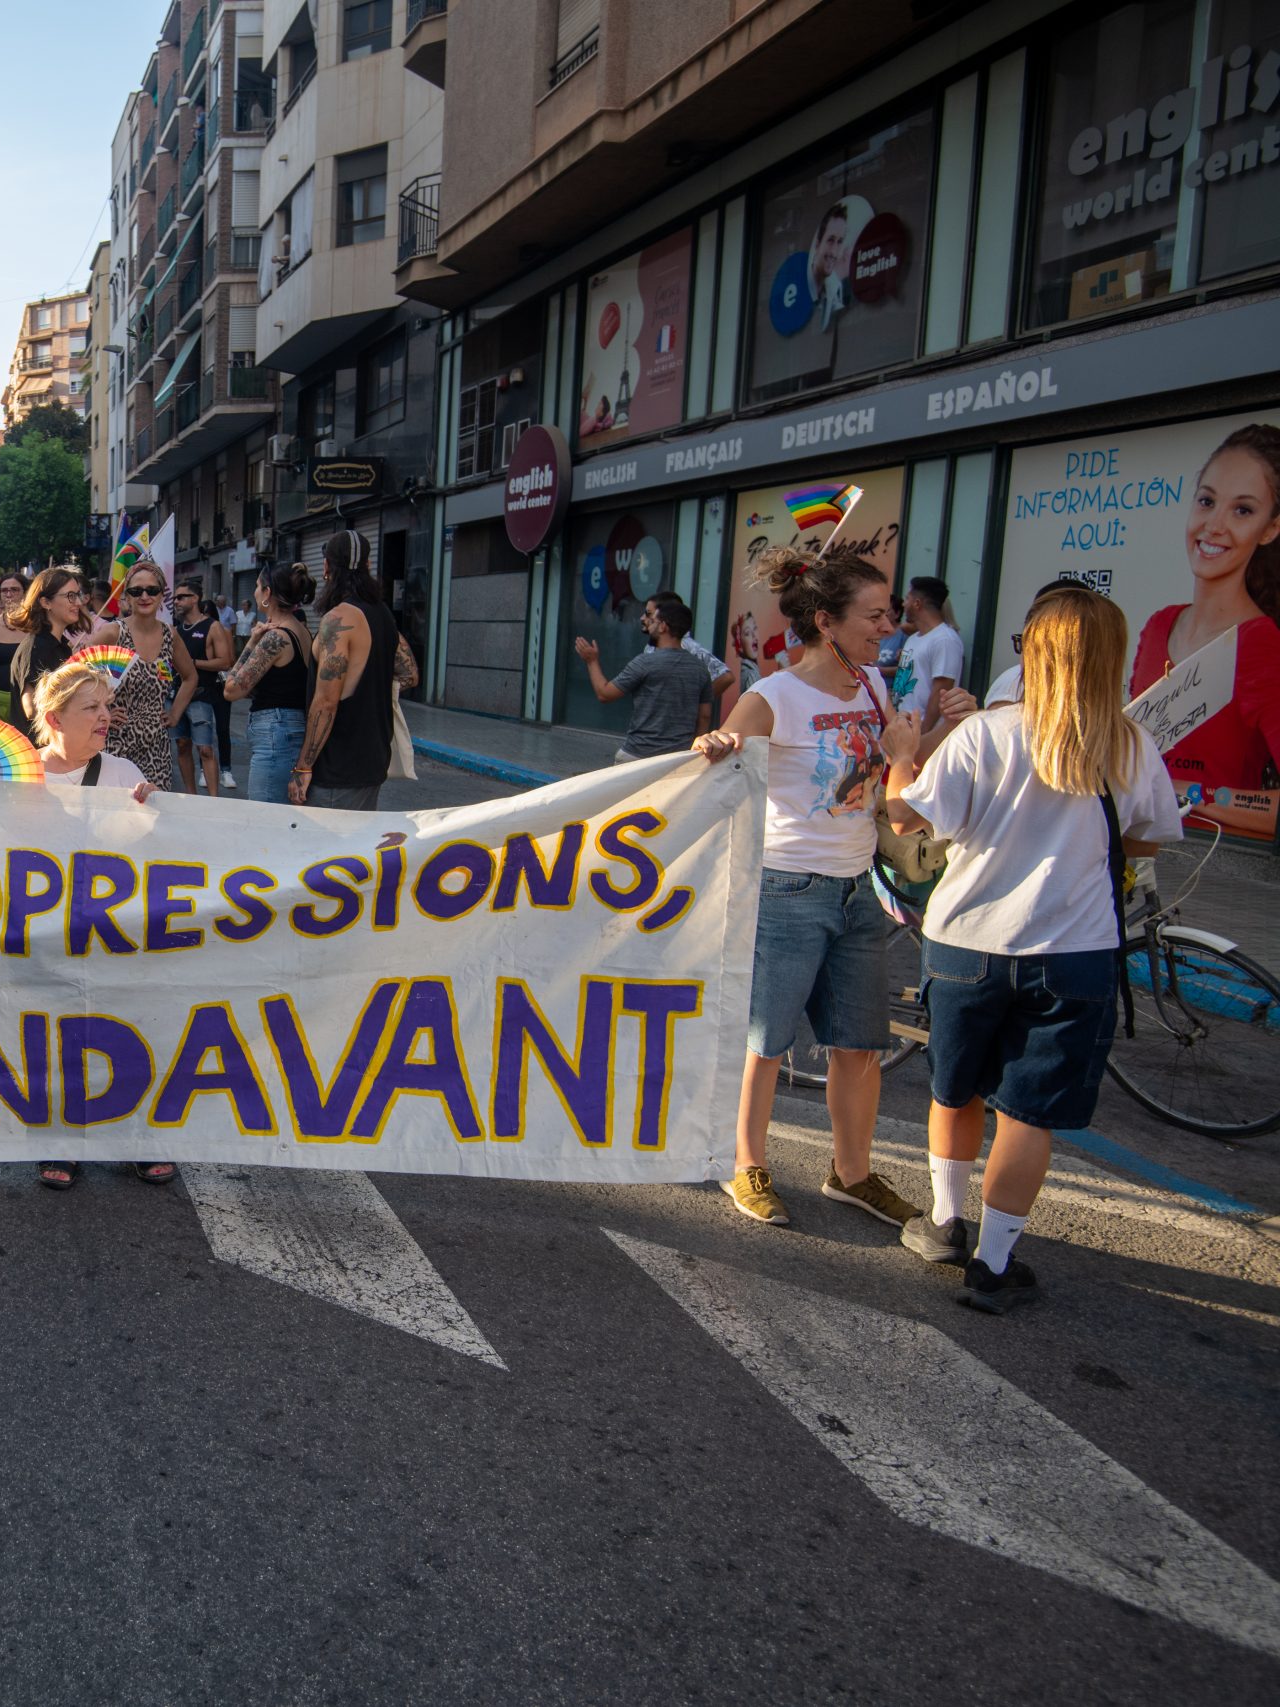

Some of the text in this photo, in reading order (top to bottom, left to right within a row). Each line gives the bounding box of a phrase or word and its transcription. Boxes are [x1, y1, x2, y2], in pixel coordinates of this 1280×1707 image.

[1067, 44, 1280, 176] englis
[1062, 125, 1280, 230] world cent
[855, 253, 898, 280] English
[857, 246, 881, 264] love
[783, 282, 799, 308] e
[584, 366, 1058, 490] ENGLISH FRANÇAIS DEUTSCH ESPAÑOL
[508, 463, 554, 496] english
[1066, 448, 1121, 480] PIDE
[507, 494, 552, 512] world center
[1014, 475, 1184, 520] INFORMACIÓN
[1061, 518, 1127, 551] AQUÍ:
[1153, 701, 1207, 751] OTESTA
[1164, 755, 1205, 772] r.com
[1234, 792, 1272, 807] english
